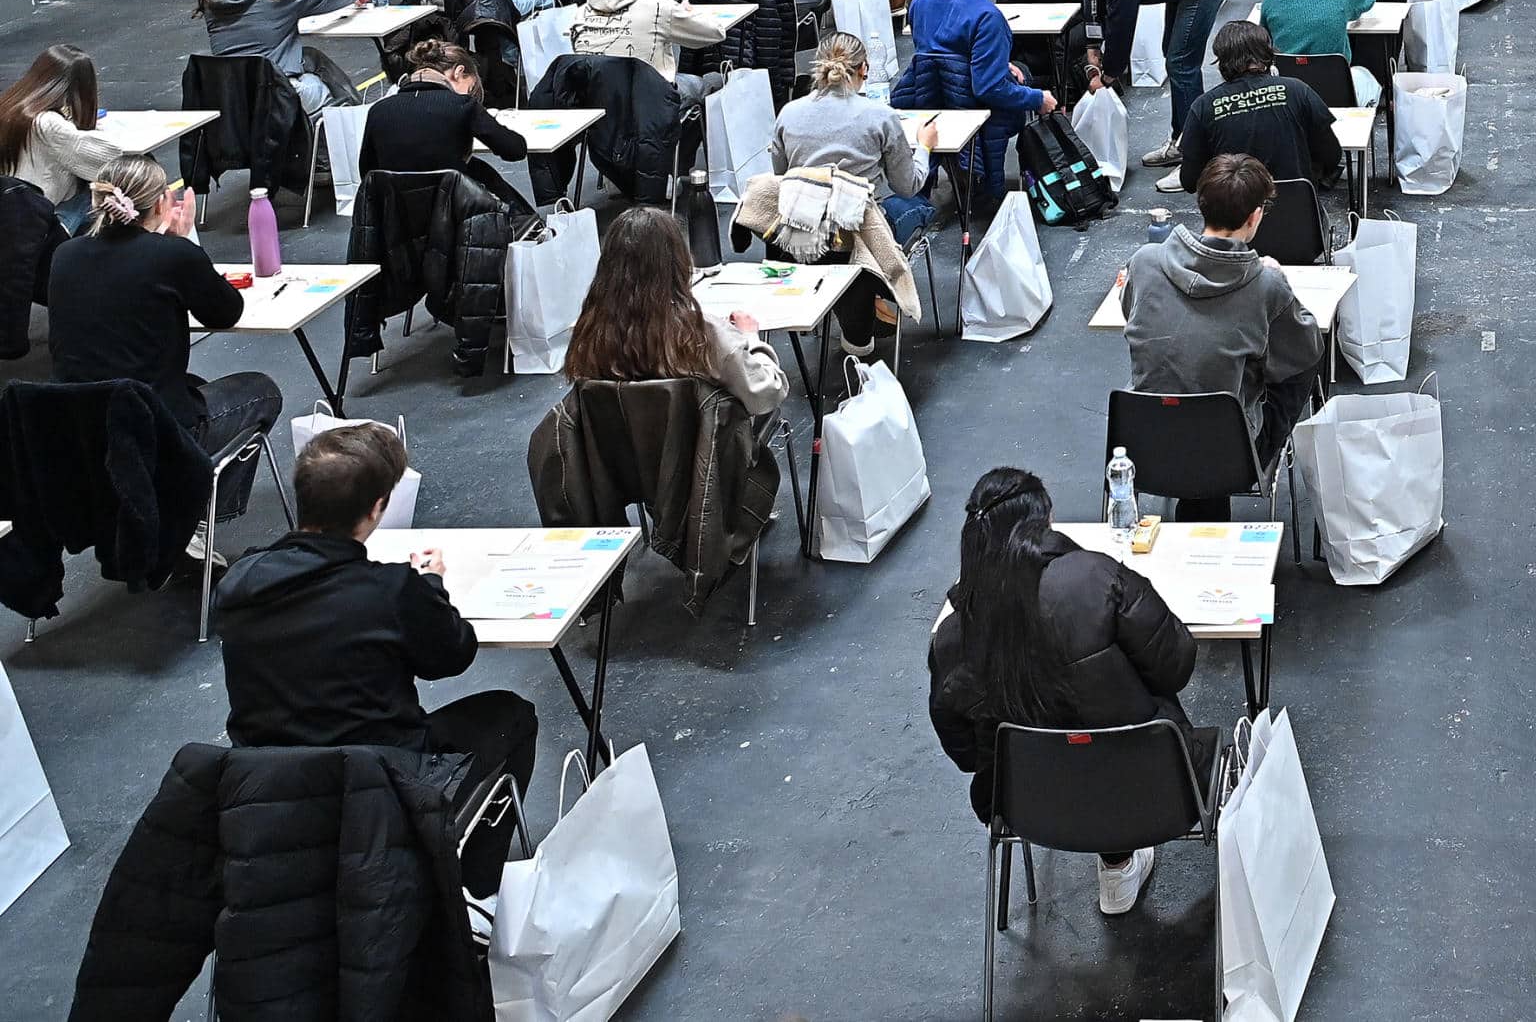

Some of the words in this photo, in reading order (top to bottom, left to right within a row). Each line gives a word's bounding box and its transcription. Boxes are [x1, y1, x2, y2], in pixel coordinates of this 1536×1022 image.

[1212, 85, 1286, 107] GROUNDED
[1214, 103, 1236, 115] BY
[1237, 92, 1287, 108] SLUGS
